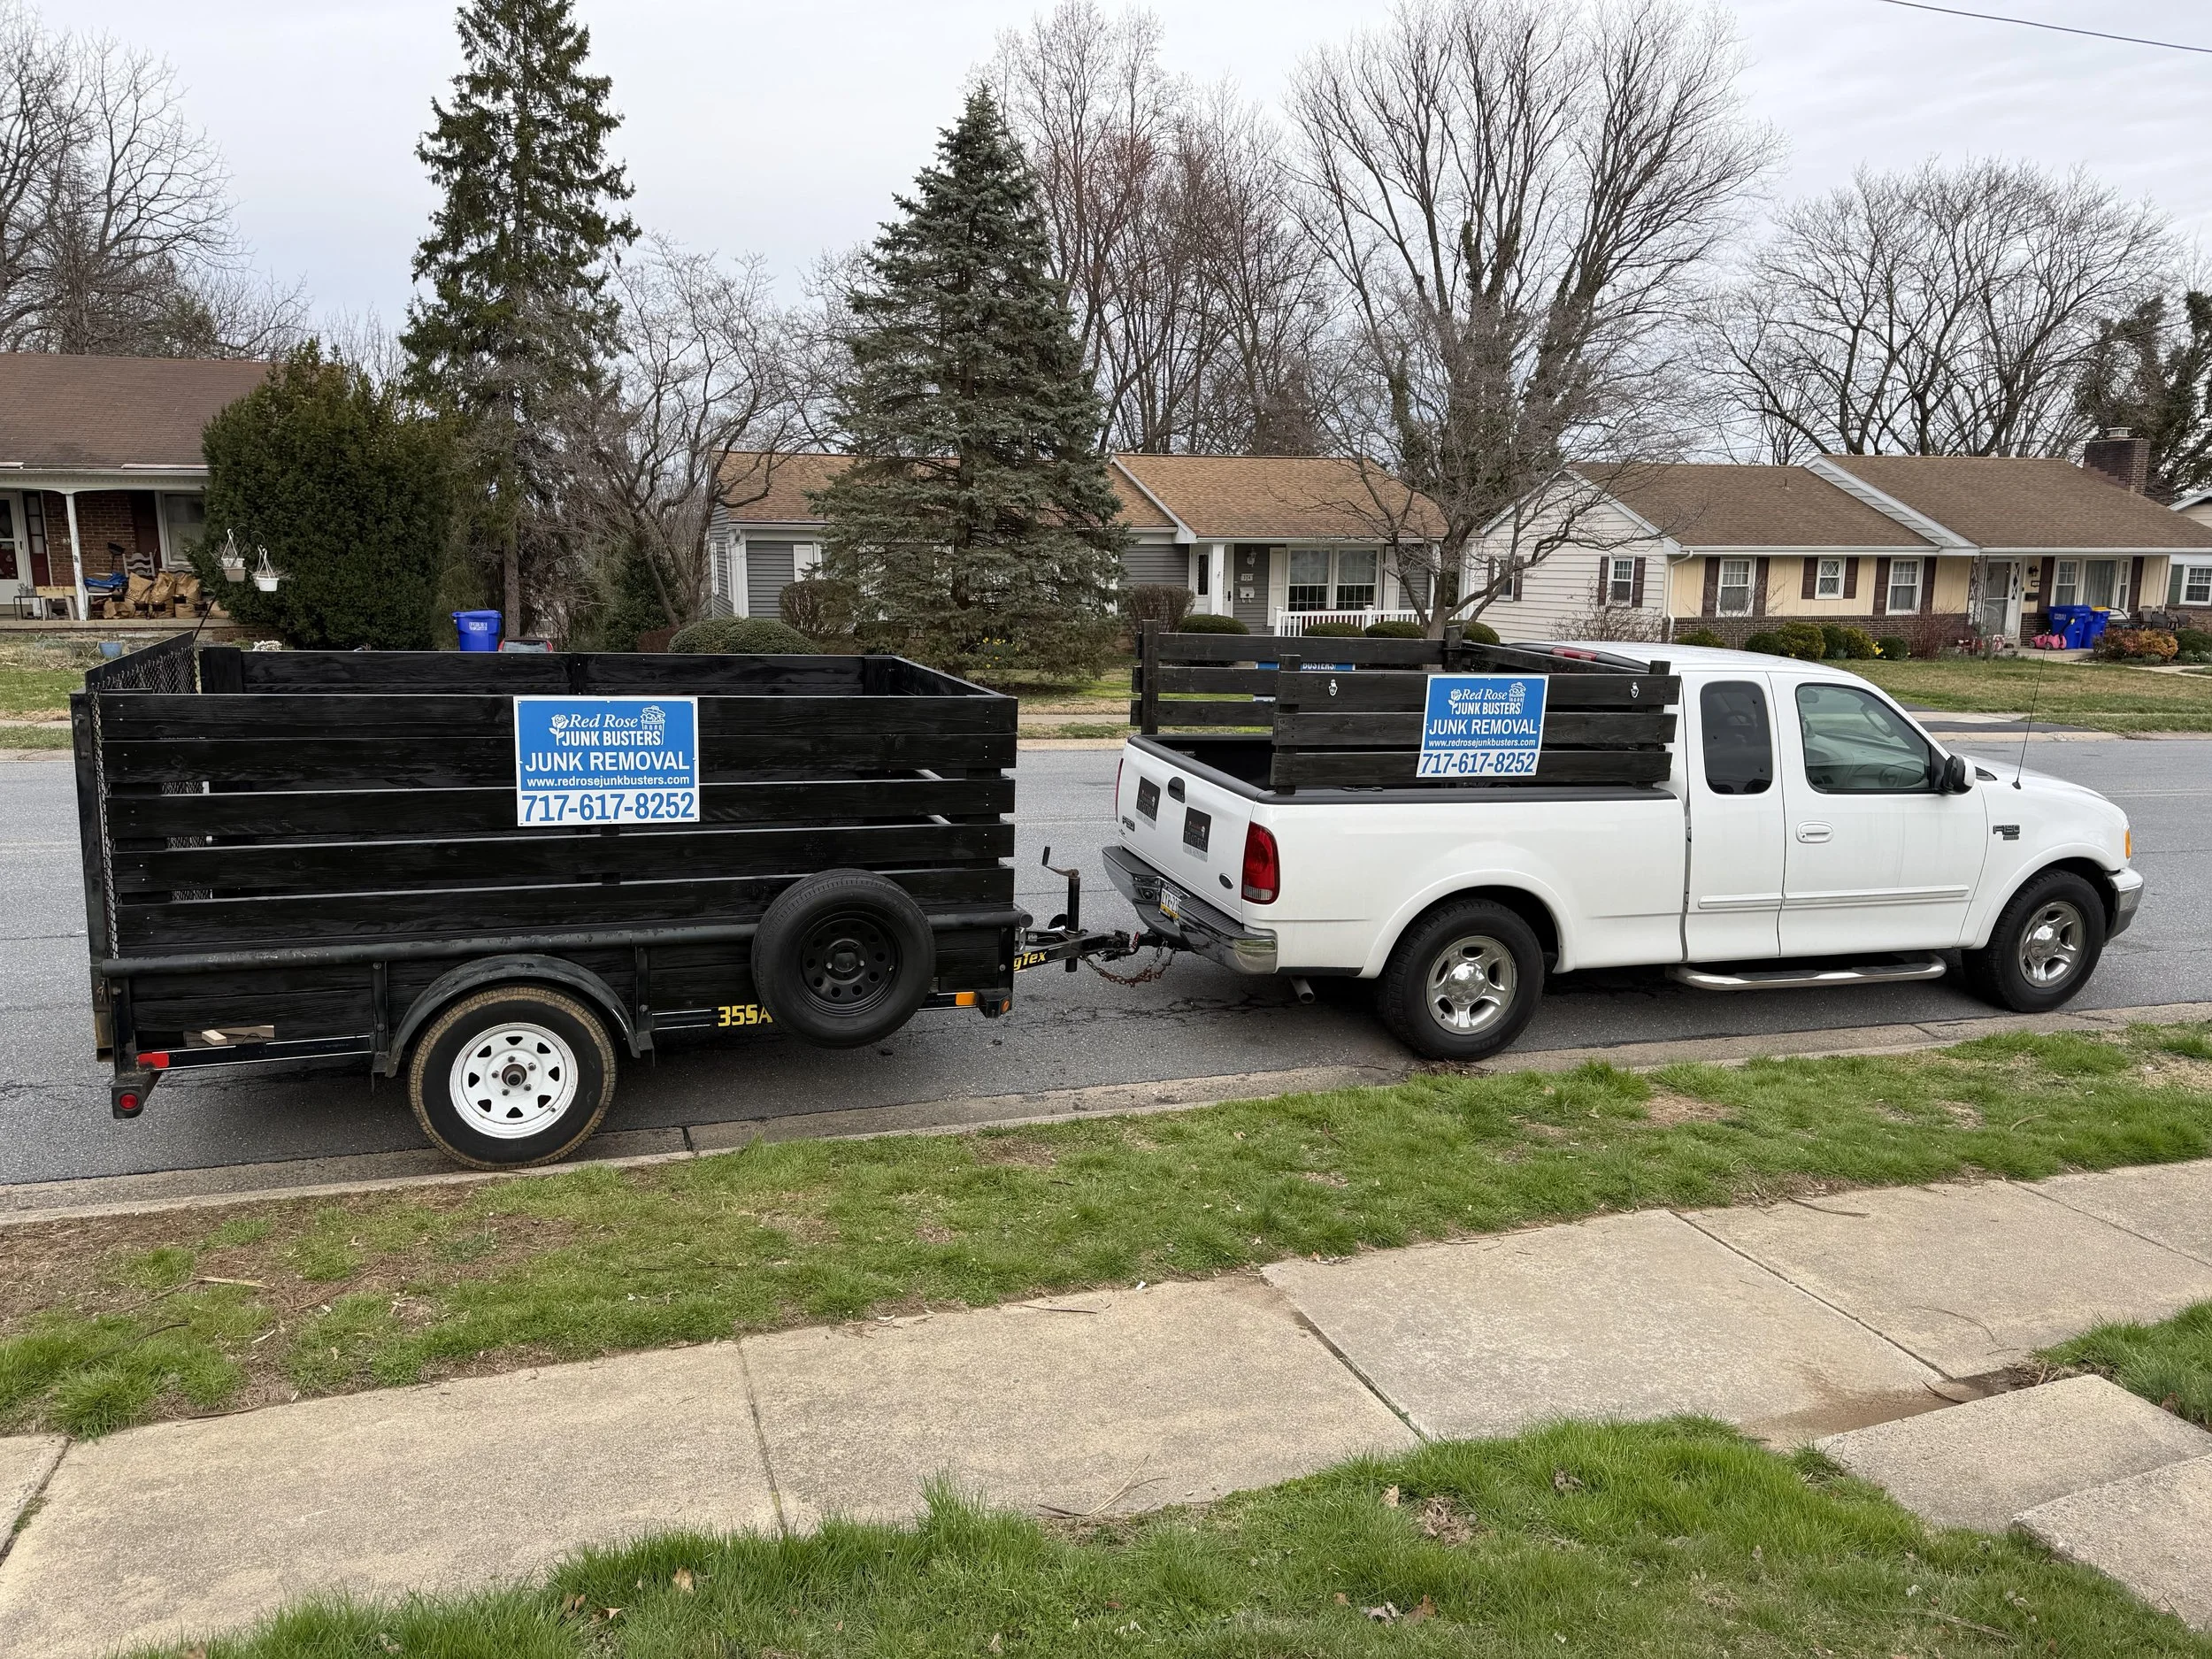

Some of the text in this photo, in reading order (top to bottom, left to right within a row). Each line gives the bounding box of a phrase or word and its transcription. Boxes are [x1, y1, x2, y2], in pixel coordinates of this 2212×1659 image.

[1461, 688, 1508, 701] Red Rose
[1455, 702, 1521, 715] JUNK BUSTERS
[569, 713, 638, 728] Red Rose
[1429, 718, 1537, 735] JUNK REMOVAL
[562, 730, 662, 747] JUNK BUSTERS
[1428, 738, 1536, 748] www.redrosejunkbusters.com
[525, 750, 690, 772] JUNK REMOVAL
[1421, 752, 1536, 774] 717-617-8252
[526, 774, 690, 788] www.redrosejunkbusters.com
[521, 792, 695, 822] 717-617-8252
[1013, 951, 1047, 971] gTex
